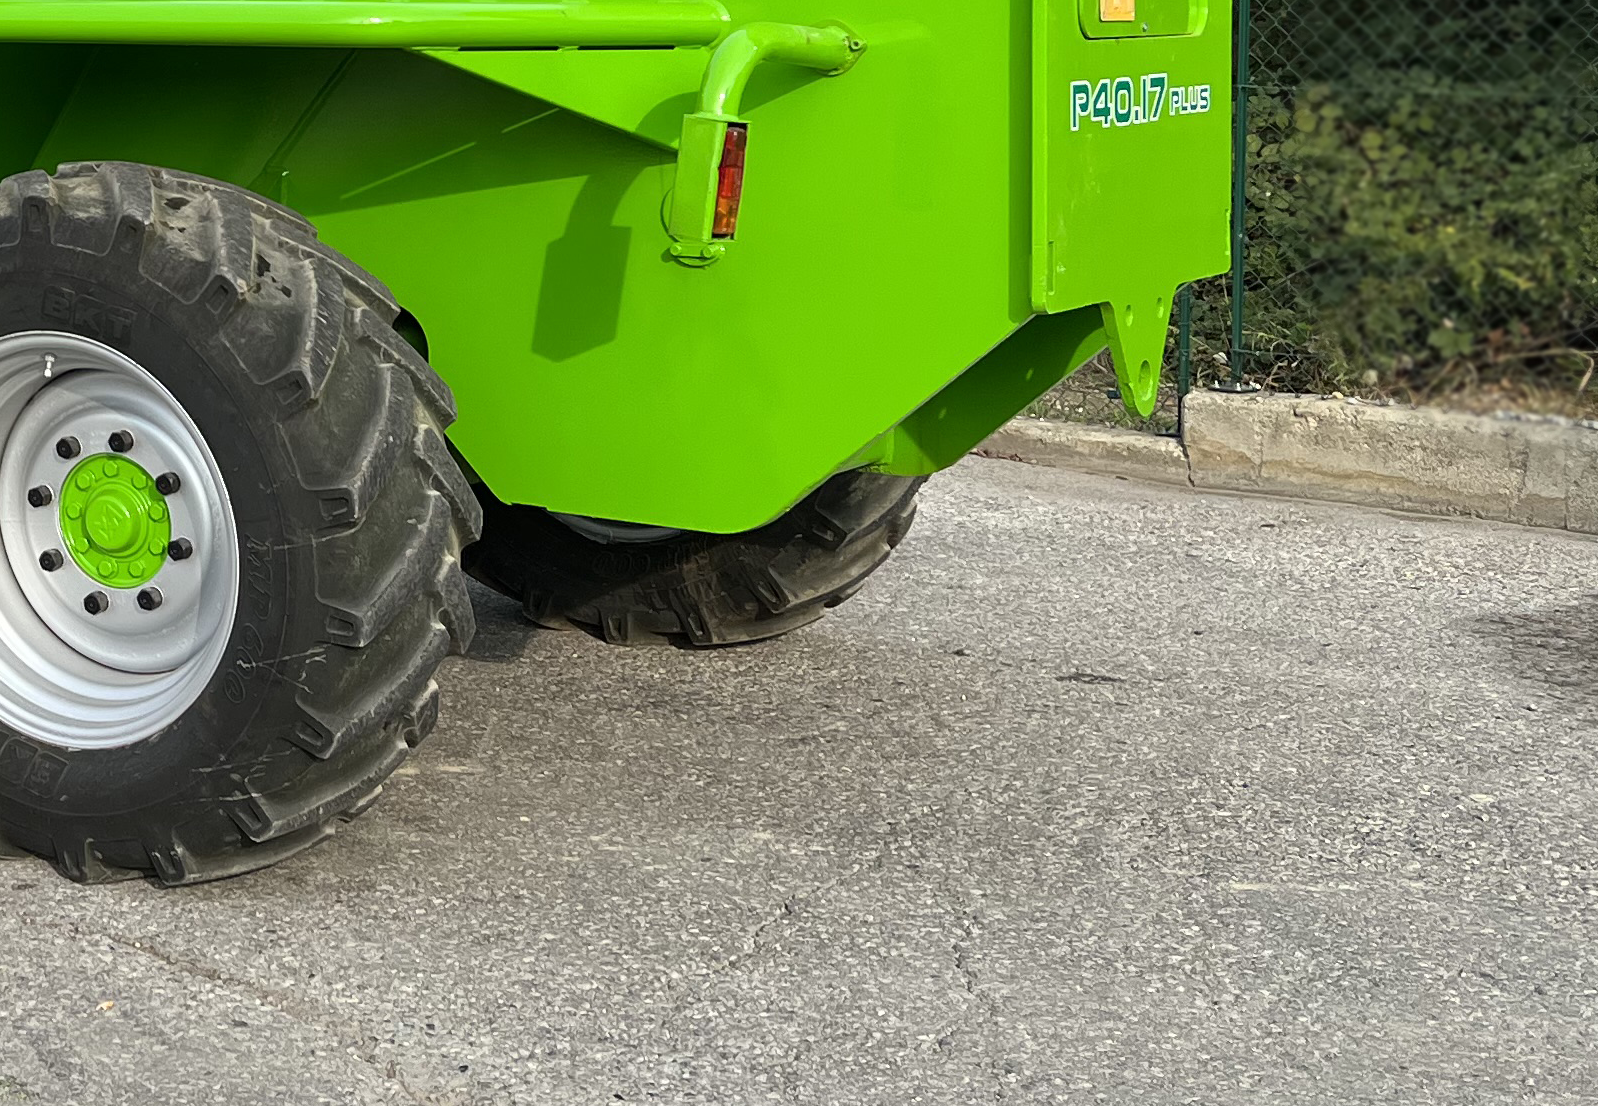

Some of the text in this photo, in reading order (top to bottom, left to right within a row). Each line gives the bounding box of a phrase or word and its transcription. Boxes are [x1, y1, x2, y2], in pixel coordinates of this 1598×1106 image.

[1070, 72, 1211, 131] P40.17 PLUS
[41, 286, 137, 344] BKT
